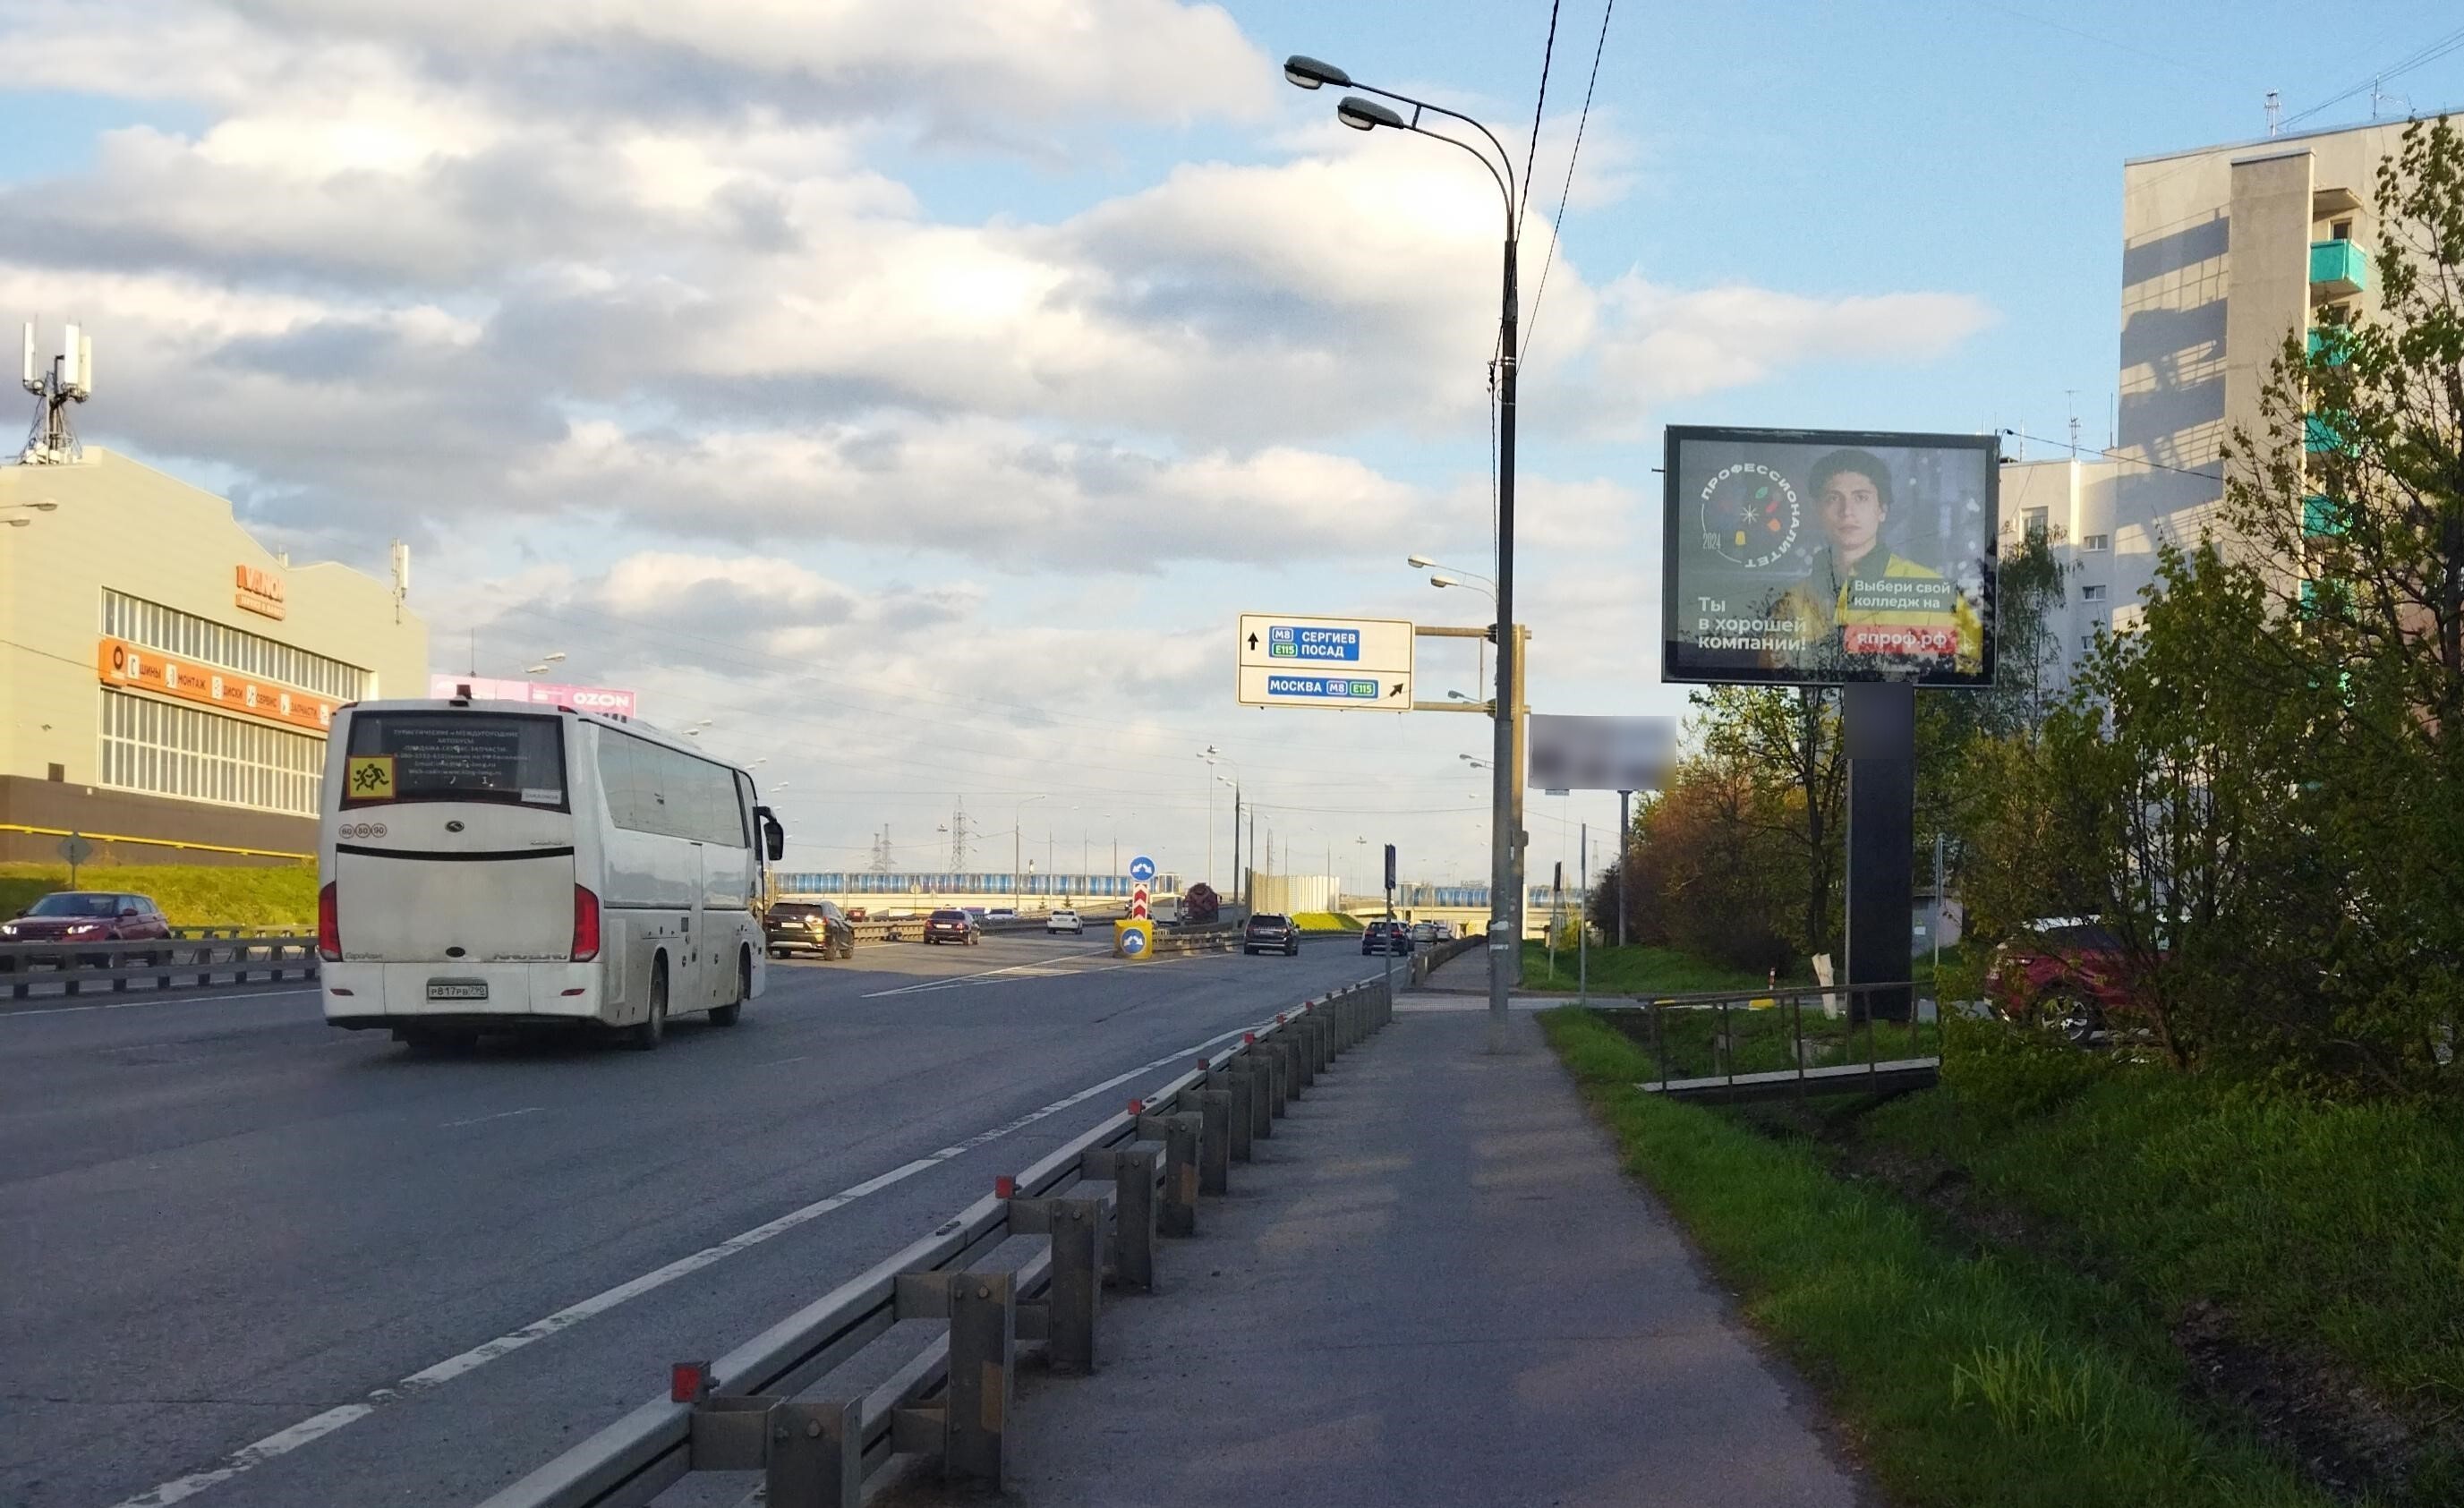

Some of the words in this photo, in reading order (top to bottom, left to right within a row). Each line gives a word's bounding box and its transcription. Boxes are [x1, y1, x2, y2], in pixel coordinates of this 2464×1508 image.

[1701, 463, 1800, 567] ПРОФЕССИОНАЛИТЕТ
[1702, 532, 1720, 550] 2024
[1854, 580, 1913, 594] Выбери
[1916, 582, 1951, 594] свой
[1698, 597, 1726, 612] Ты
[1854, 596, 1919, 609] колледж
[1924, 599, 1940, 609] на
[1699, 618, 1709, 630] в
[1715, 617, 1806, 635] хорошей
[1275, 629, 1291, 640] М8
[1301, 631, 1356, 644] СЕРГИЕВ
[1698, 636, 1806, 651] компании!
[1857, 631, 1948, 649] япроф.рф
[1301, 644, 1344, 658] ПОСАД
[139, 663, 161, 679] ШИНЫ
[178, 675, 207, 690] МОНТАЖ
[224, 686, 243, 699] ДИСКИ
[1269, 680, 1322, 693] МОСКВА
[1329, 683, 1344, 693] М8
[573, 692, 629, 707] OZON
